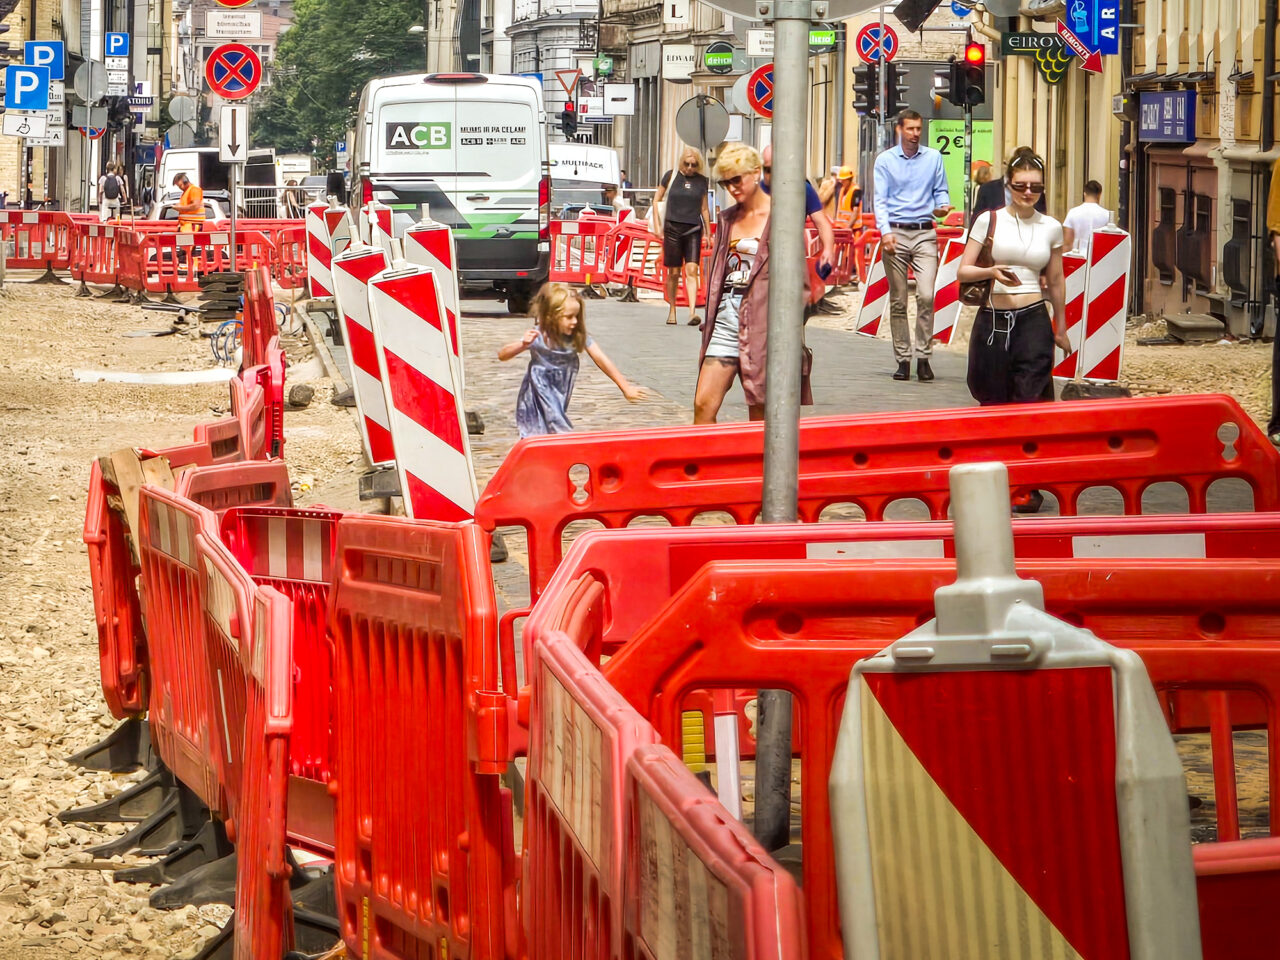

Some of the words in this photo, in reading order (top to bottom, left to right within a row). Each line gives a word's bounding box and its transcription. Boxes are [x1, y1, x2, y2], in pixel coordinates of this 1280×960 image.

[110, 35, 124, 53] P
[33, 46, 55, 66] P
[14, 70, 40, 104] P
[390, 125, 448, 146] ACB
